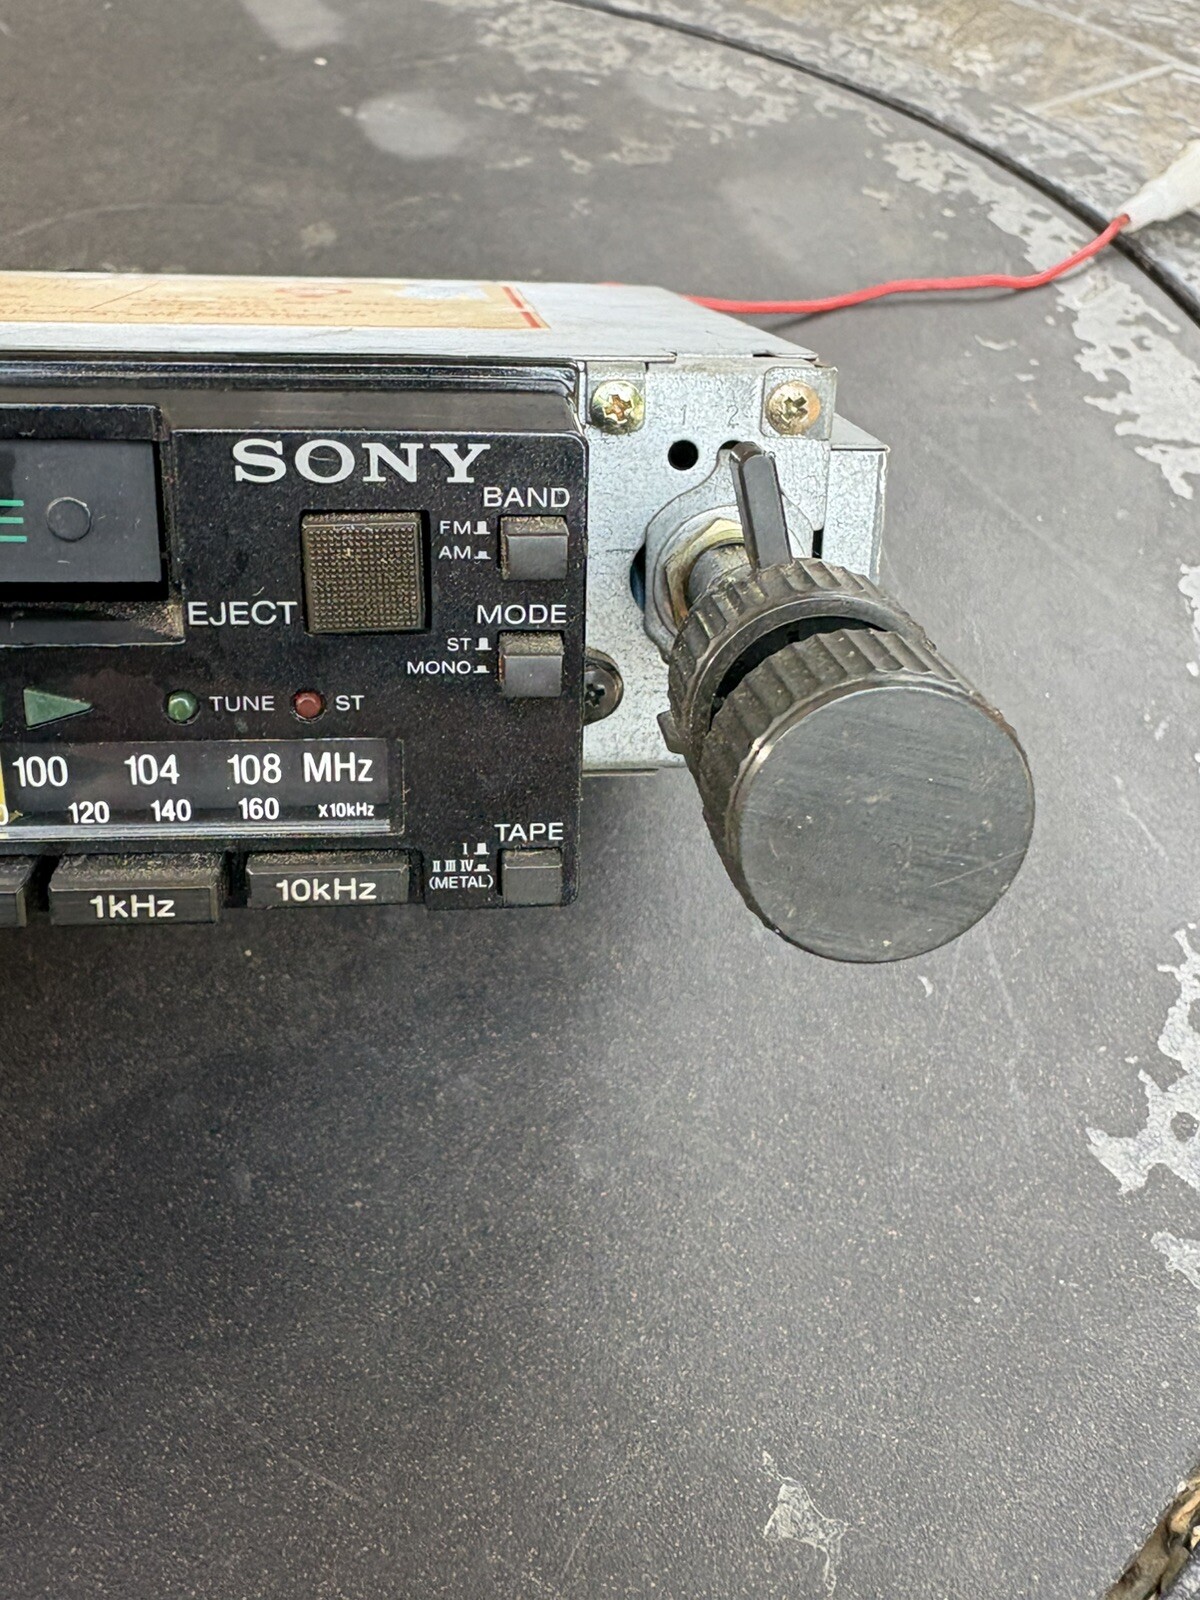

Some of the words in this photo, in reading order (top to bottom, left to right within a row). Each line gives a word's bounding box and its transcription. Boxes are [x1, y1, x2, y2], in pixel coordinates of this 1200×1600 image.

[233, 439, 491, 484] SONY
[483, 487, 571, 508] BAND
[440, 521, 472, 535] FM
[438, 547, 472, 560] AM
[188, 601, 297, 626] EJECT
[476, 604, 567, 624] MODE
[447, 638, 472, 650] ST
[407, 661, 472, 674] MONO
[209, 696, 275, 711] TUNE
[335, 696, 364, 710] ST
[12, 756, 68, 788] 100
[124, 754, 180, 785] 104
[227, 754, 282, 785] 108
[303, 752, 373, 783] MHz
[68, 801, 110, 823] 120
[150, 799, 192, 822] 140
[238, 798, 280, 820] 160
[494, 822, 564, 842] TAPE
[275, 878, 377, 901] 10kHz
[429, 875, 494, 890] (METAL)
[90, 894, 177, 918] 1kHz
